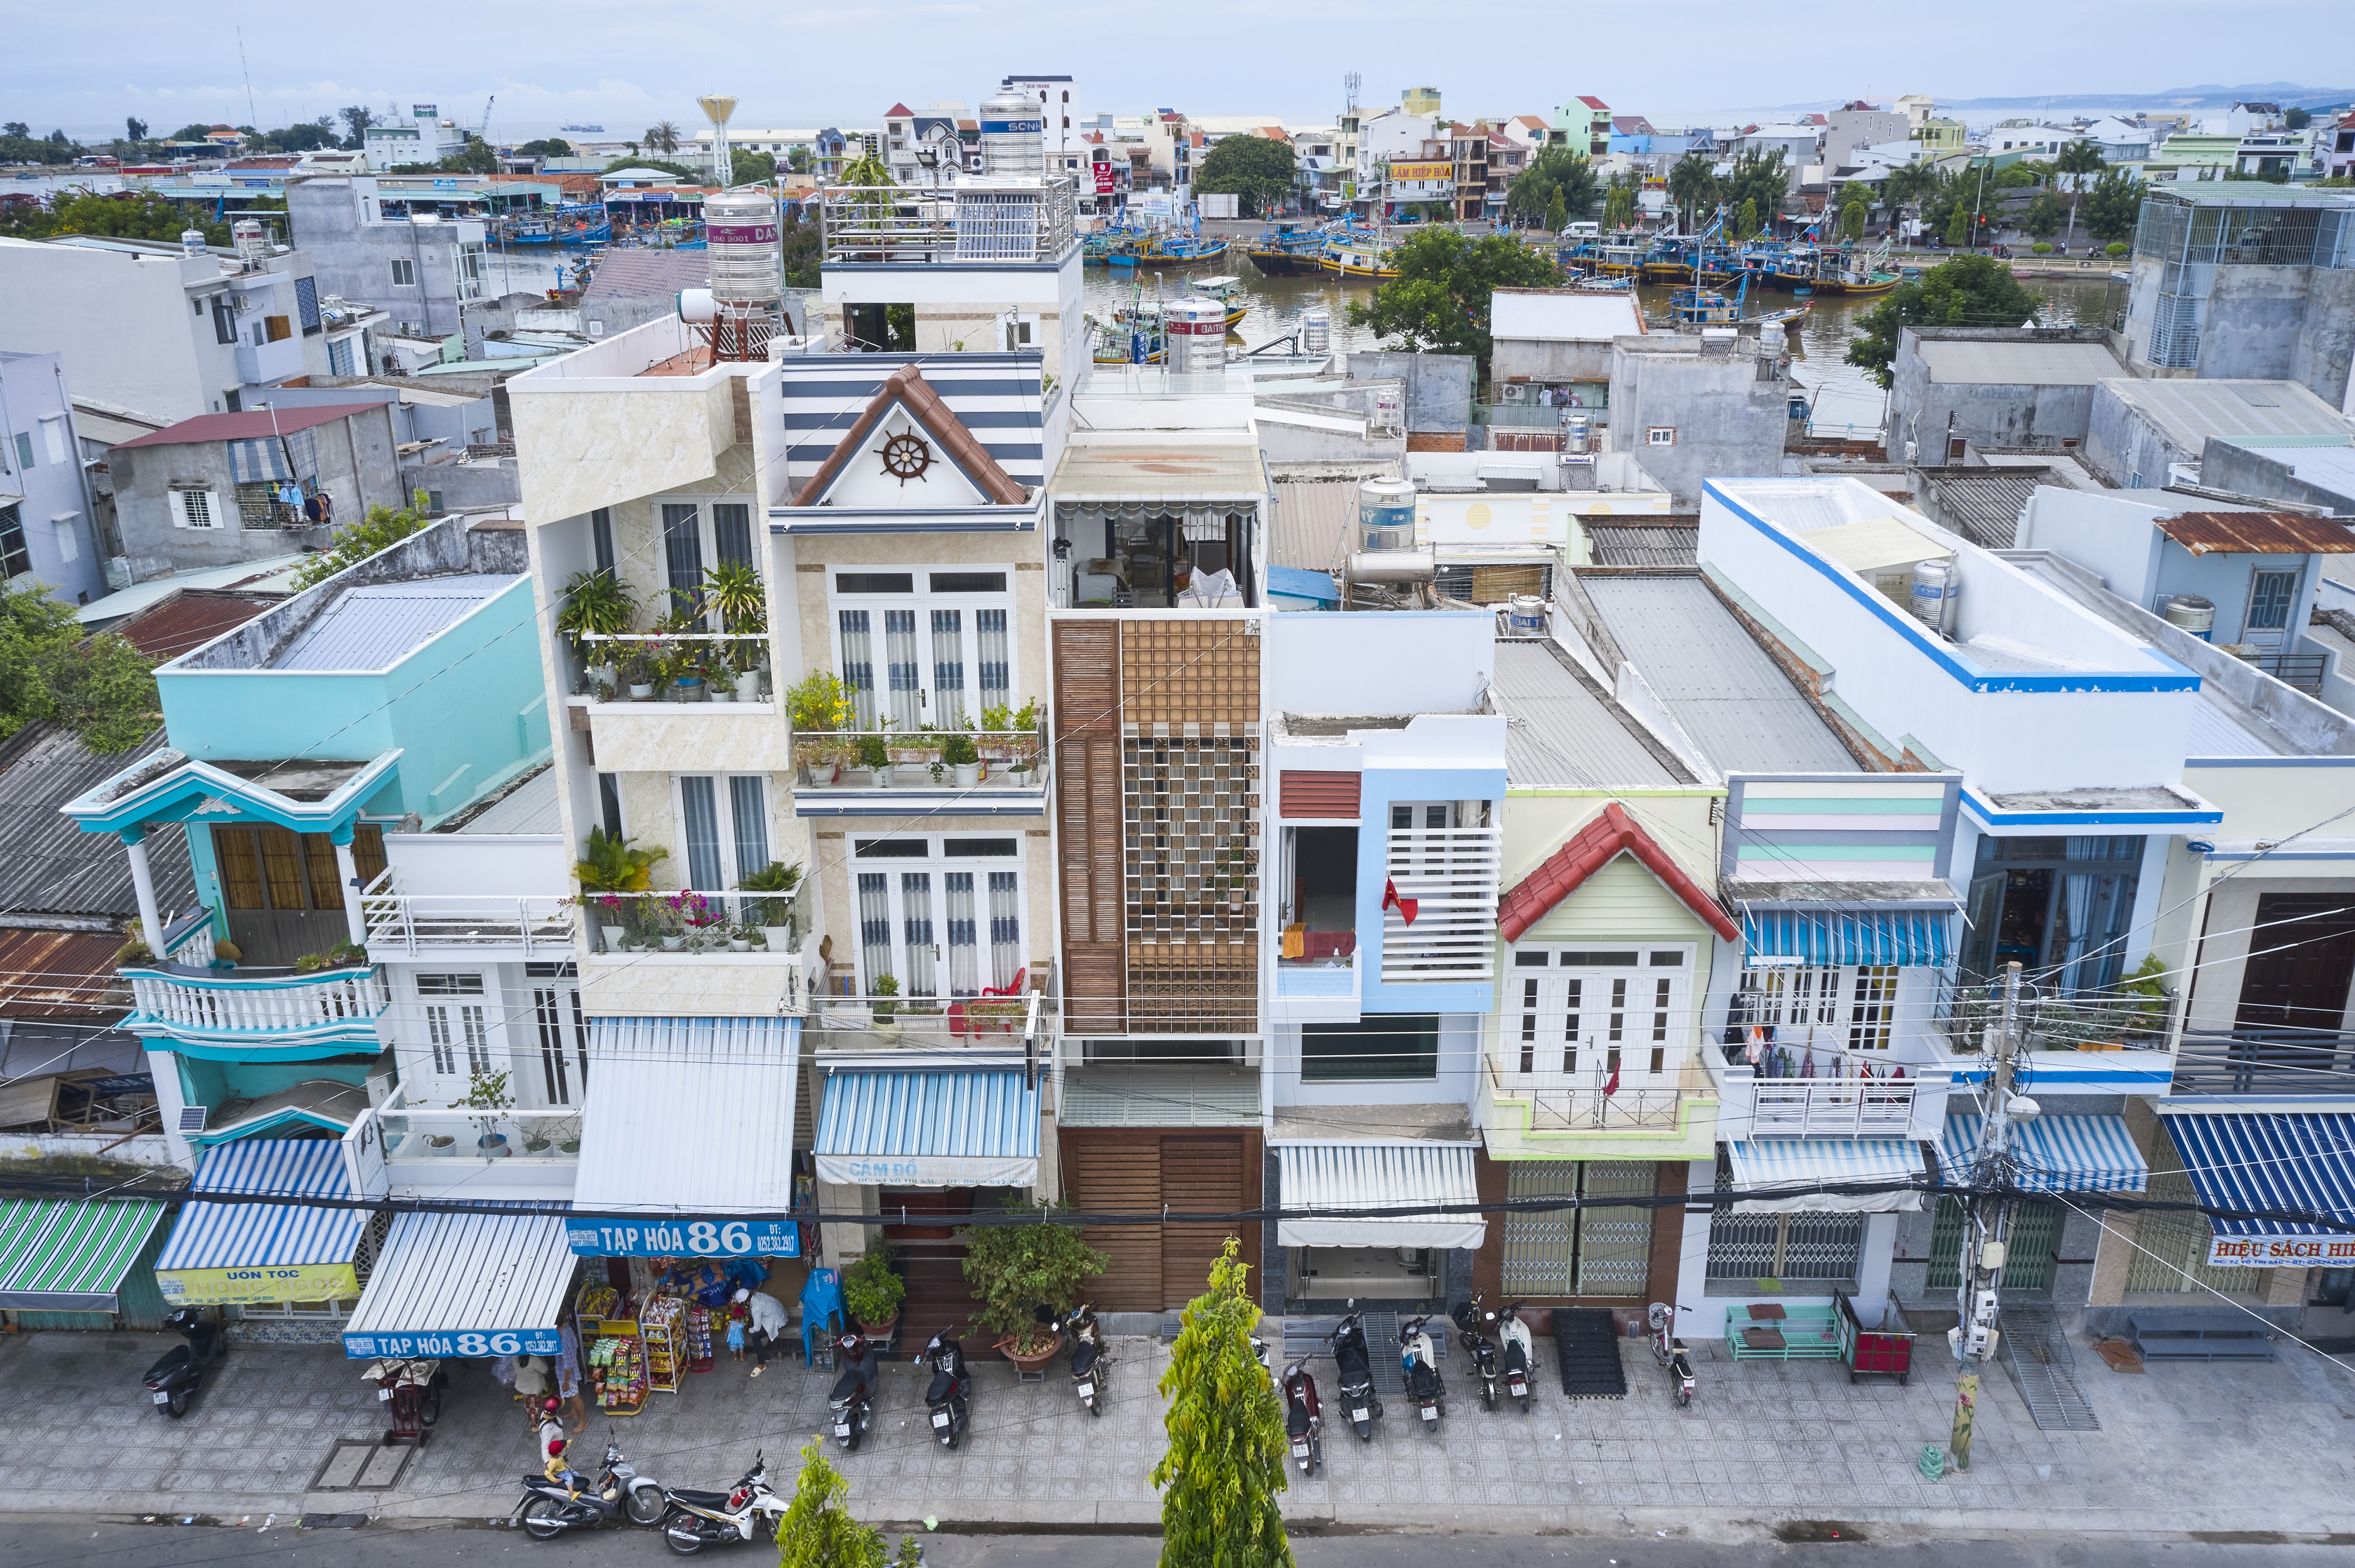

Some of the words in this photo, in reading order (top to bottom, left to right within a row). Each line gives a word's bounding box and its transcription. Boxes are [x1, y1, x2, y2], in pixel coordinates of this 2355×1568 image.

[1392, 167, 1409, 177] LÂM
[1412, 166, 1431, 179] HIỆP
[1434, 165, 1450, 177] HÒA
[849, 1158, 888, 1177] CẦM
[893, 1158, 917, 1177] ĐỒ
[769, 1224, 781, 1235] ĐT:
[600, 1227, 638, 1256] TẠP
[644, 1221, 685, 1251] HÓA
[688, 1221, 752, 1253] 86
[757, 1235, 794, 1252] 0252.382.2917
[2215, 1239, 2264, 1259] HIỆU
[2270, 1239, 2322, 1257] SÁCH
[227, 1268, 262, 1280] UỐN
[266, 1268, 299, 1278] TÓC
[274, 1277, 346, 1294] NGỌC
[535, 1331, 545, 1340] ĐT:
[378, 1338, 412, 1358] TẠP
[417, 1333, 454, 1354] HÓA
[457, 1333, 521, 1355] 86
[525, 1340, 557, 1352] 0252.382.2917
